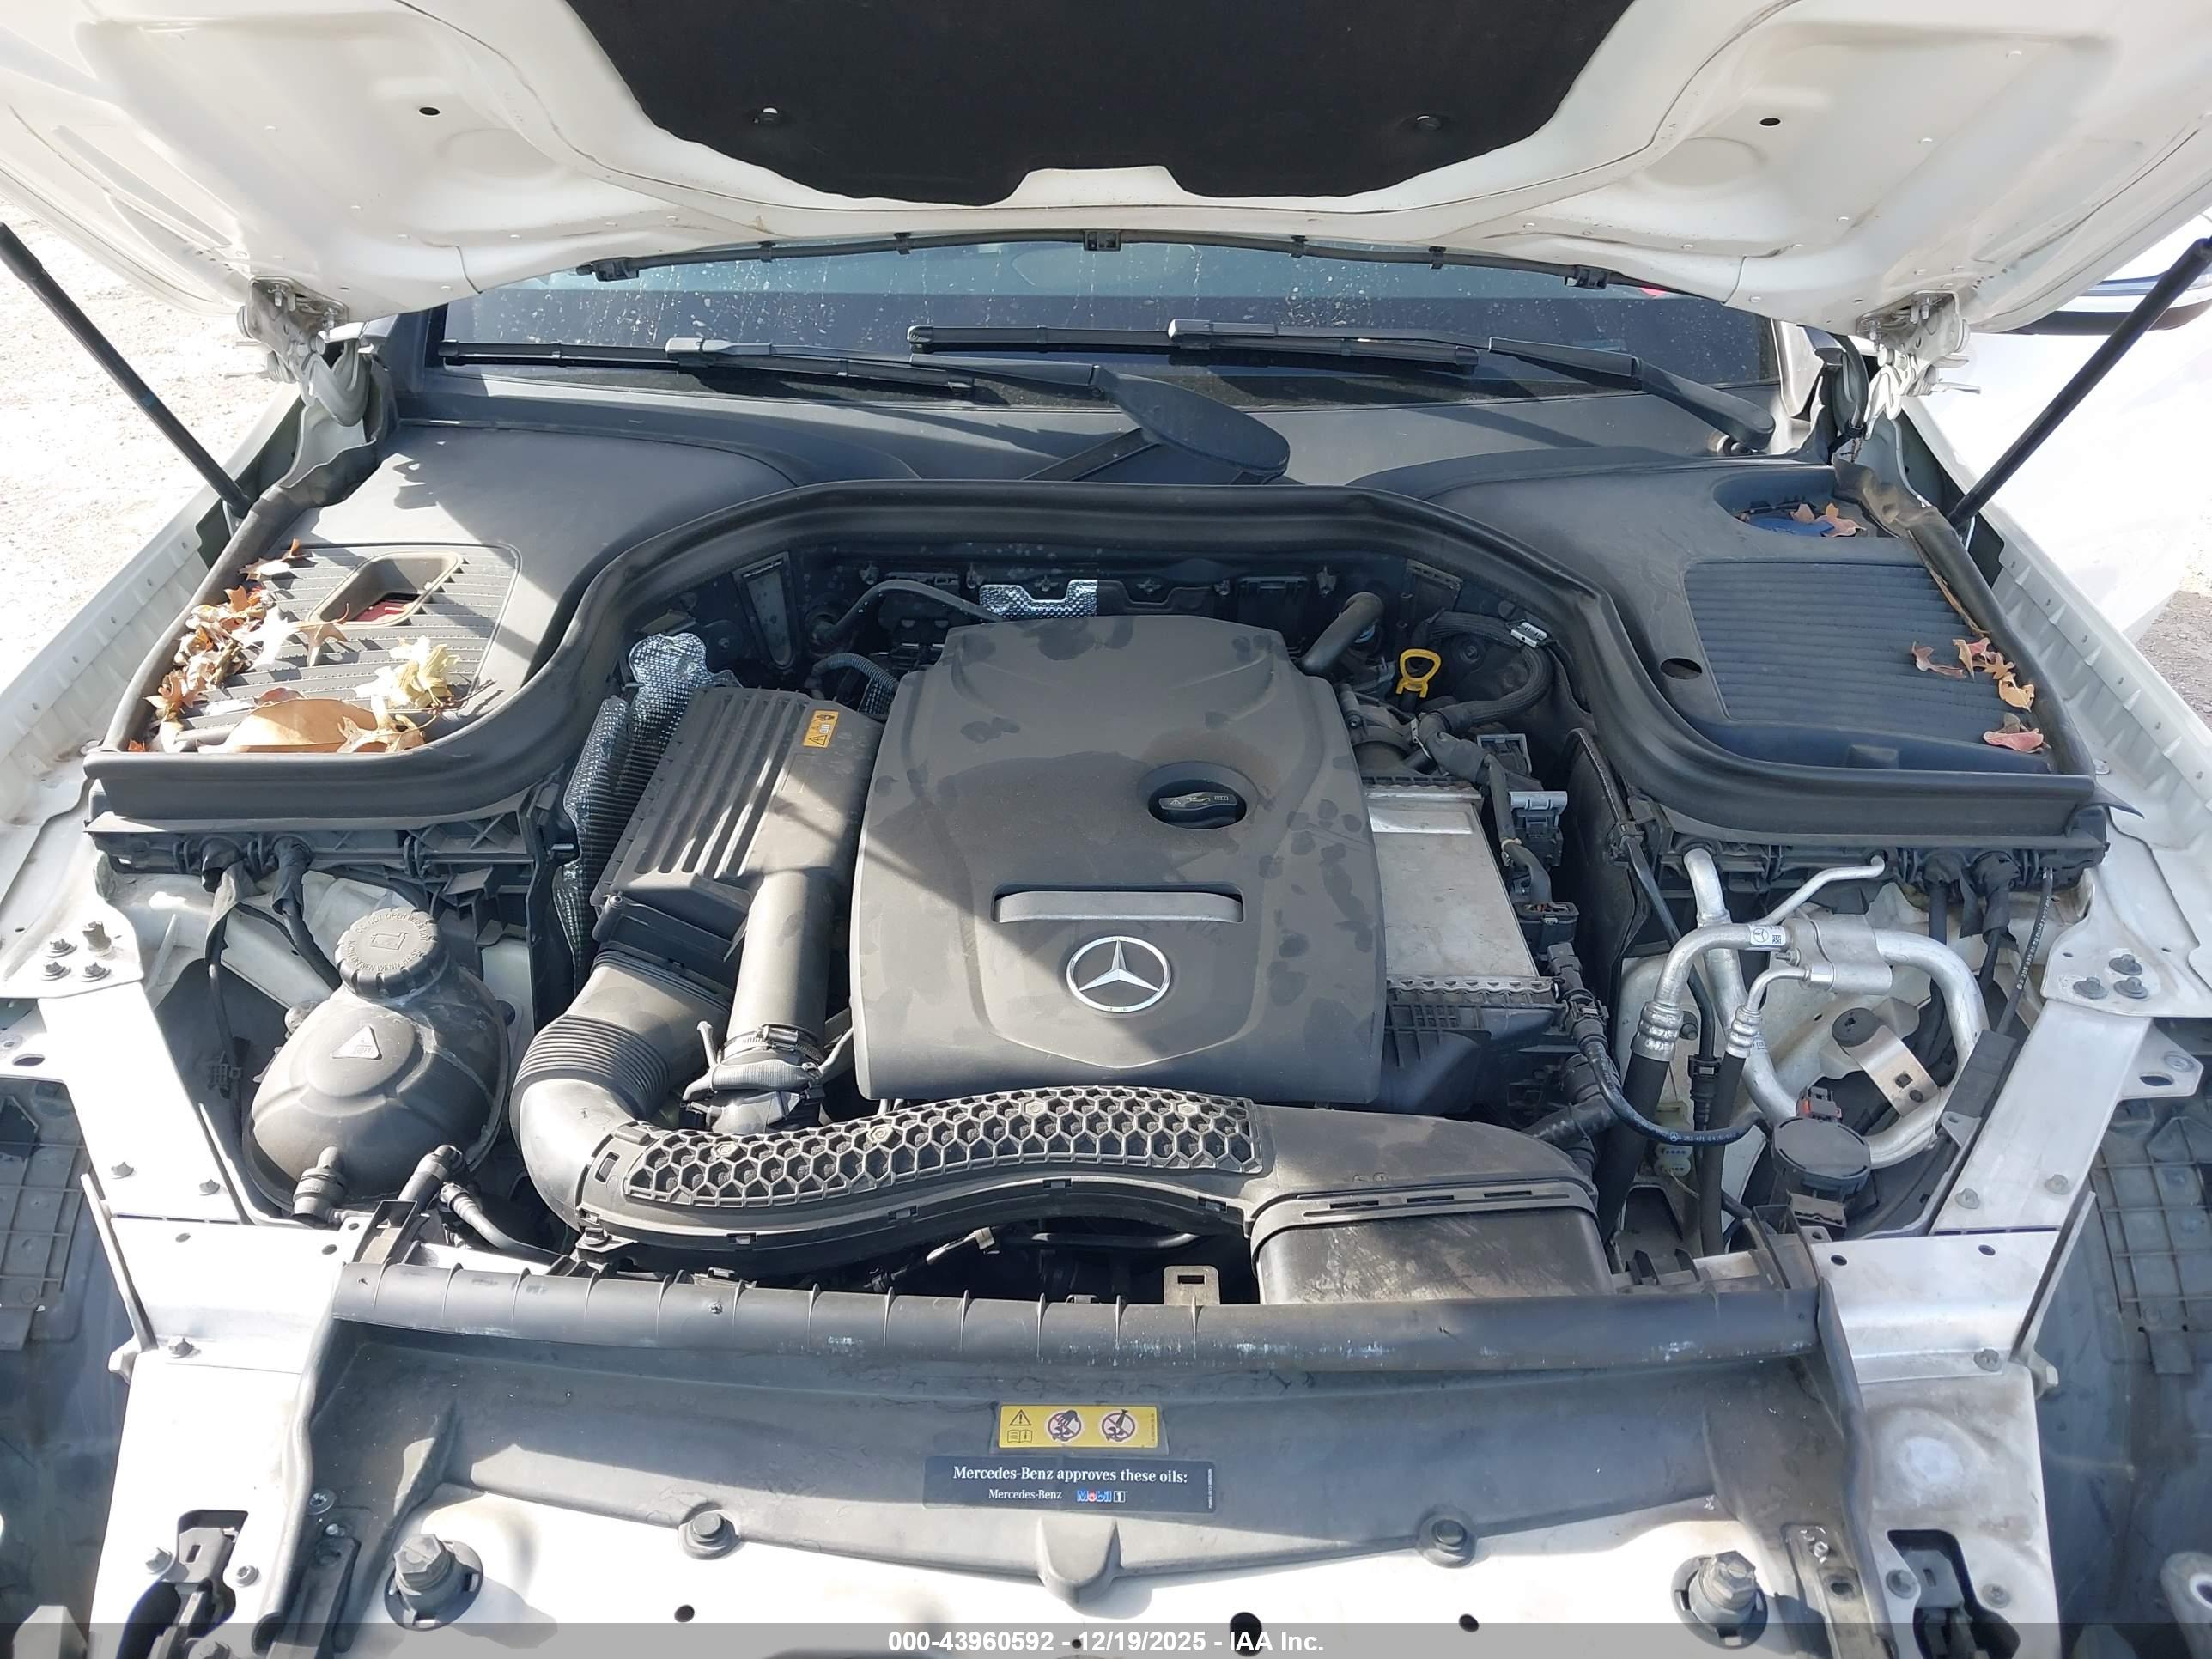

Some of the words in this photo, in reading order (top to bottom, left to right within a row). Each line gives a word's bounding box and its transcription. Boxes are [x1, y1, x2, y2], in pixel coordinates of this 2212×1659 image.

[368, 915, 384, 926] NOT
[386, 913, 408, 921] OPEN
[953, 1466, 1054, 1480] Mercedes-Benz
[1056, 1469, 1117, 1483] approves
[1120, 1468, 1156, 1482] these
[1159, 1469, 1188, 1484] oils:
[988, 1488, 1063, 1500] Mercedes-Benz
[1077, 1490, 1112, 1502] Mobil
